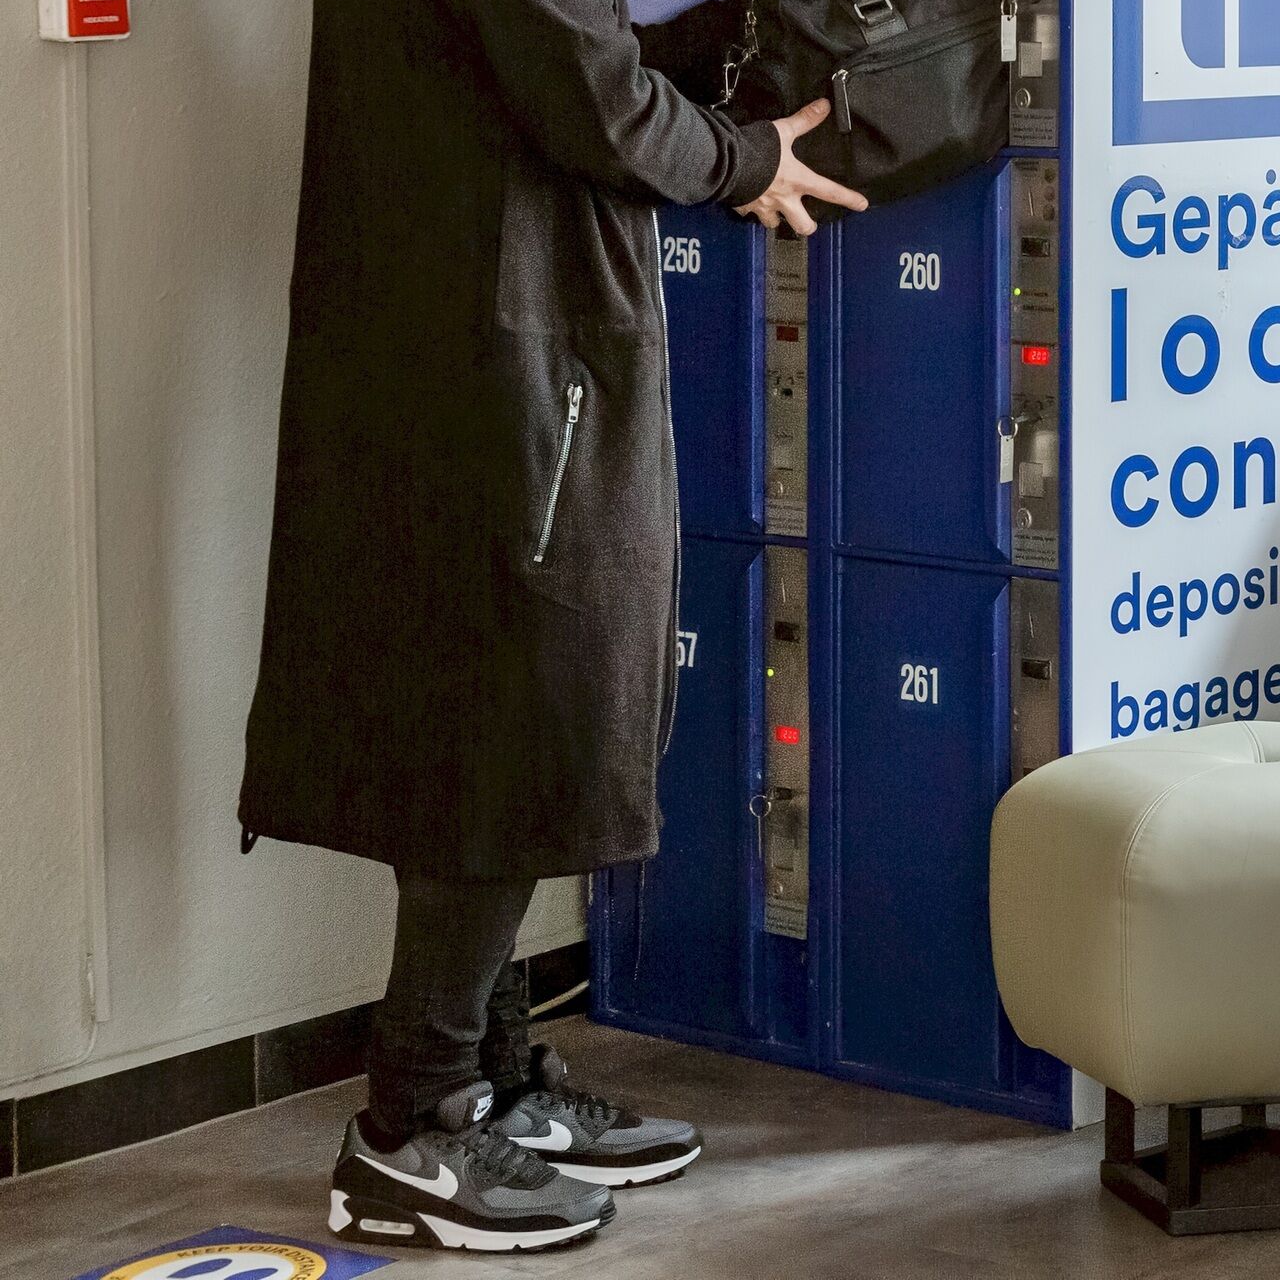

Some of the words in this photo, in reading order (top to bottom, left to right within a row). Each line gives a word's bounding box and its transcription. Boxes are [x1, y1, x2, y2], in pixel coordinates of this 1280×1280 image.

[664, 237, 700, 273] 256
[900, 253, 940, 291] 260
[676, 630, 697, 667] 57
[901, 664, 937, 704] 261
[176, 1246, 231, 1258] KEEP
